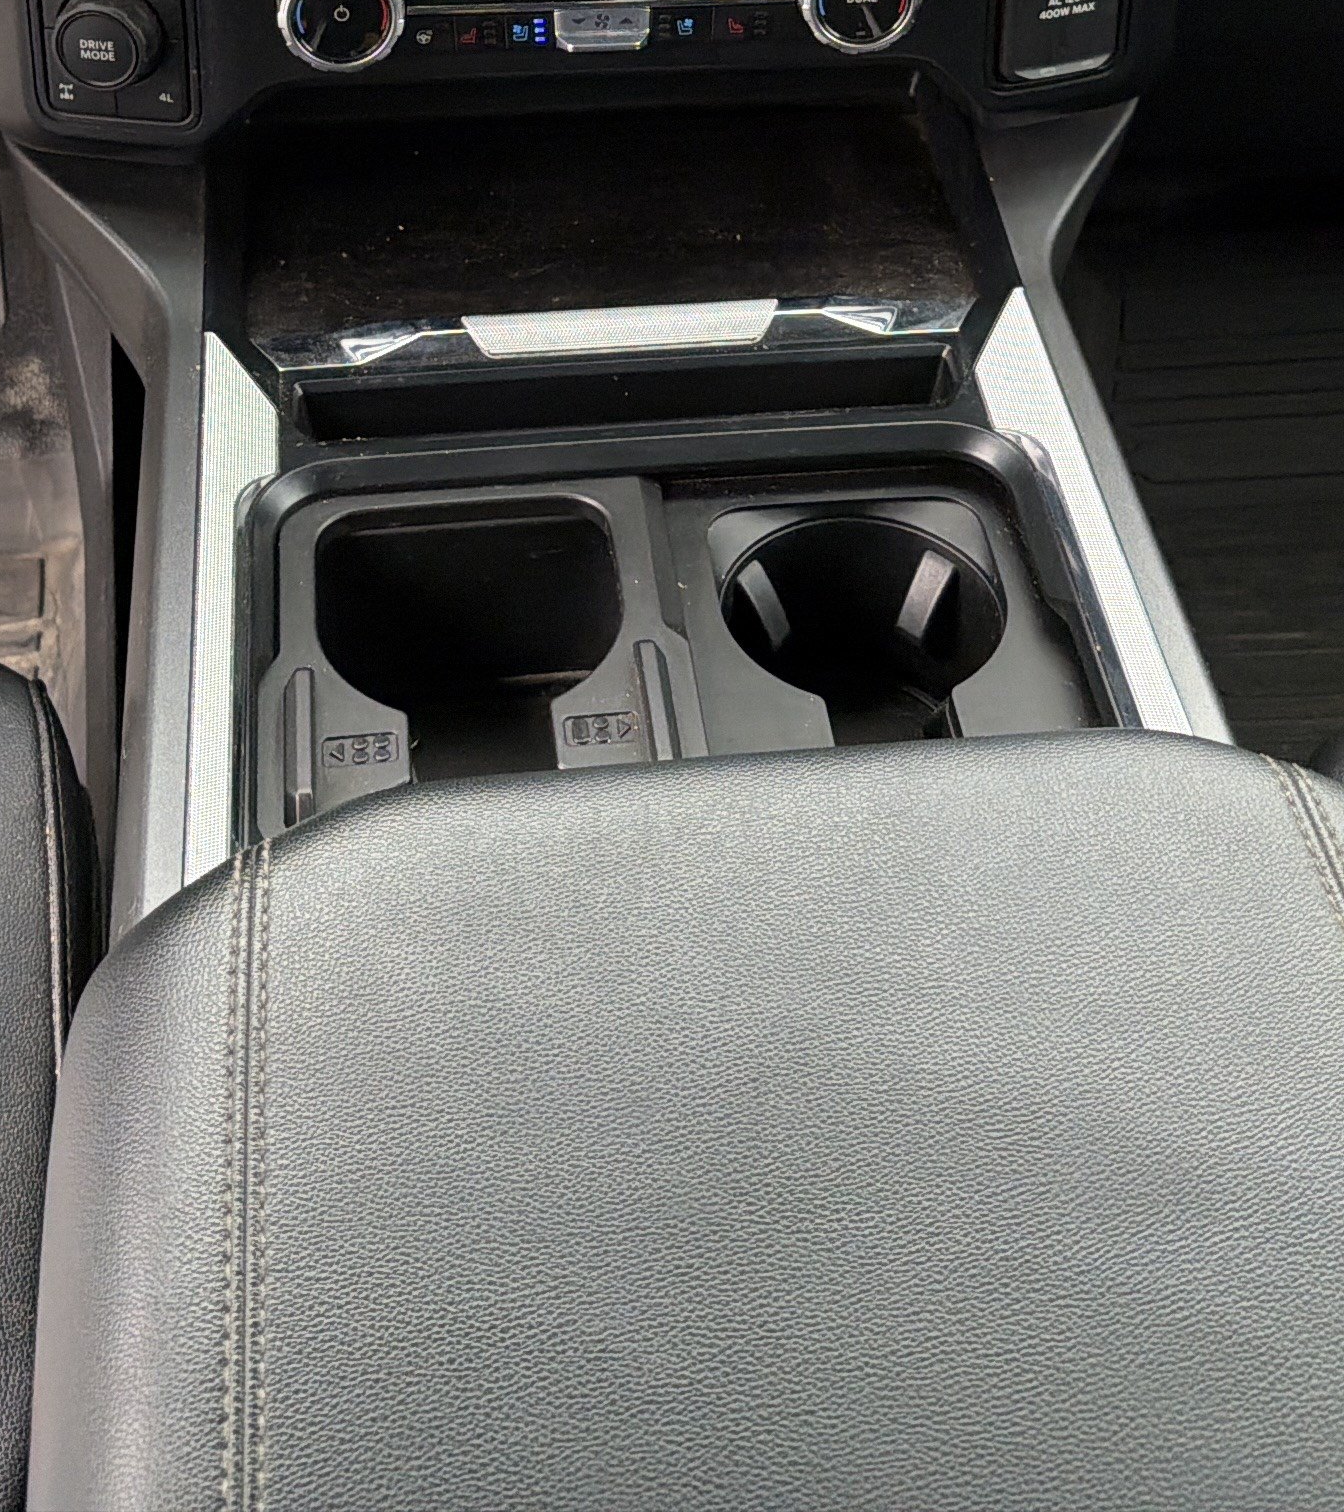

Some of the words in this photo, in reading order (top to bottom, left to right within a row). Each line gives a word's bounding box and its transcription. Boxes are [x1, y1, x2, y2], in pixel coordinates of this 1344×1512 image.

[1038, 6, 1071, 20] 400W
[1072, 2, 1097, 15] MAX
[79, 38, 115, 51] DRIVE
[79, 49, 116, 62] MODE
[158, 92, 175, 103] 4L
